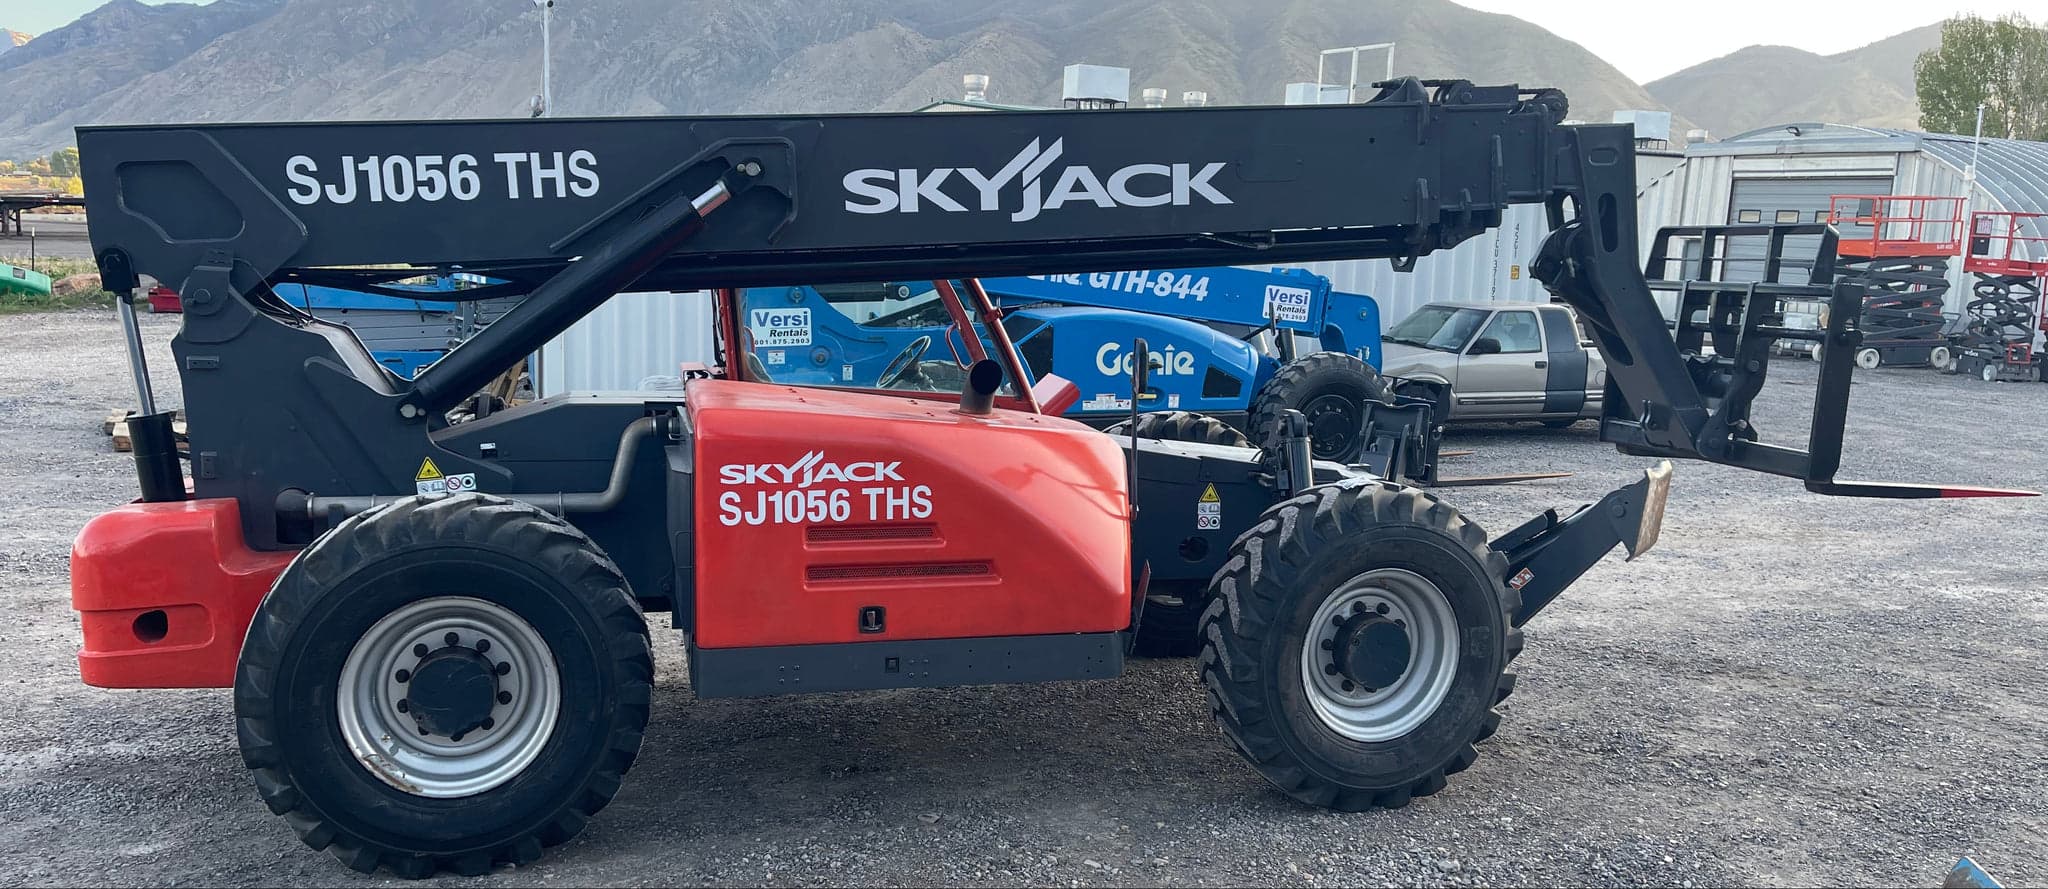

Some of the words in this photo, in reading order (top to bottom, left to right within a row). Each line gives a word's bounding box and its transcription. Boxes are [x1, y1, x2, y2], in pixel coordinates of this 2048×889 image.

[285, 153, 481, 205] SJ1056
[493, 149, 600, 199] THS
[842, 136, 1234, 222] SKYJACK
[1089, 270, 1210, 302] GTH-844
[1269, 288, 1309, 304] Versi
[754, 311, 808, 327] Versi
[1276, 304, 1306, 314] Rentals
[769, 329, 808, 337] Rentals
[719, 450, 906, 488] SKYJACK
[719, 487, 851, 527] SJ1056
[862, 484, 934, 521] THS
